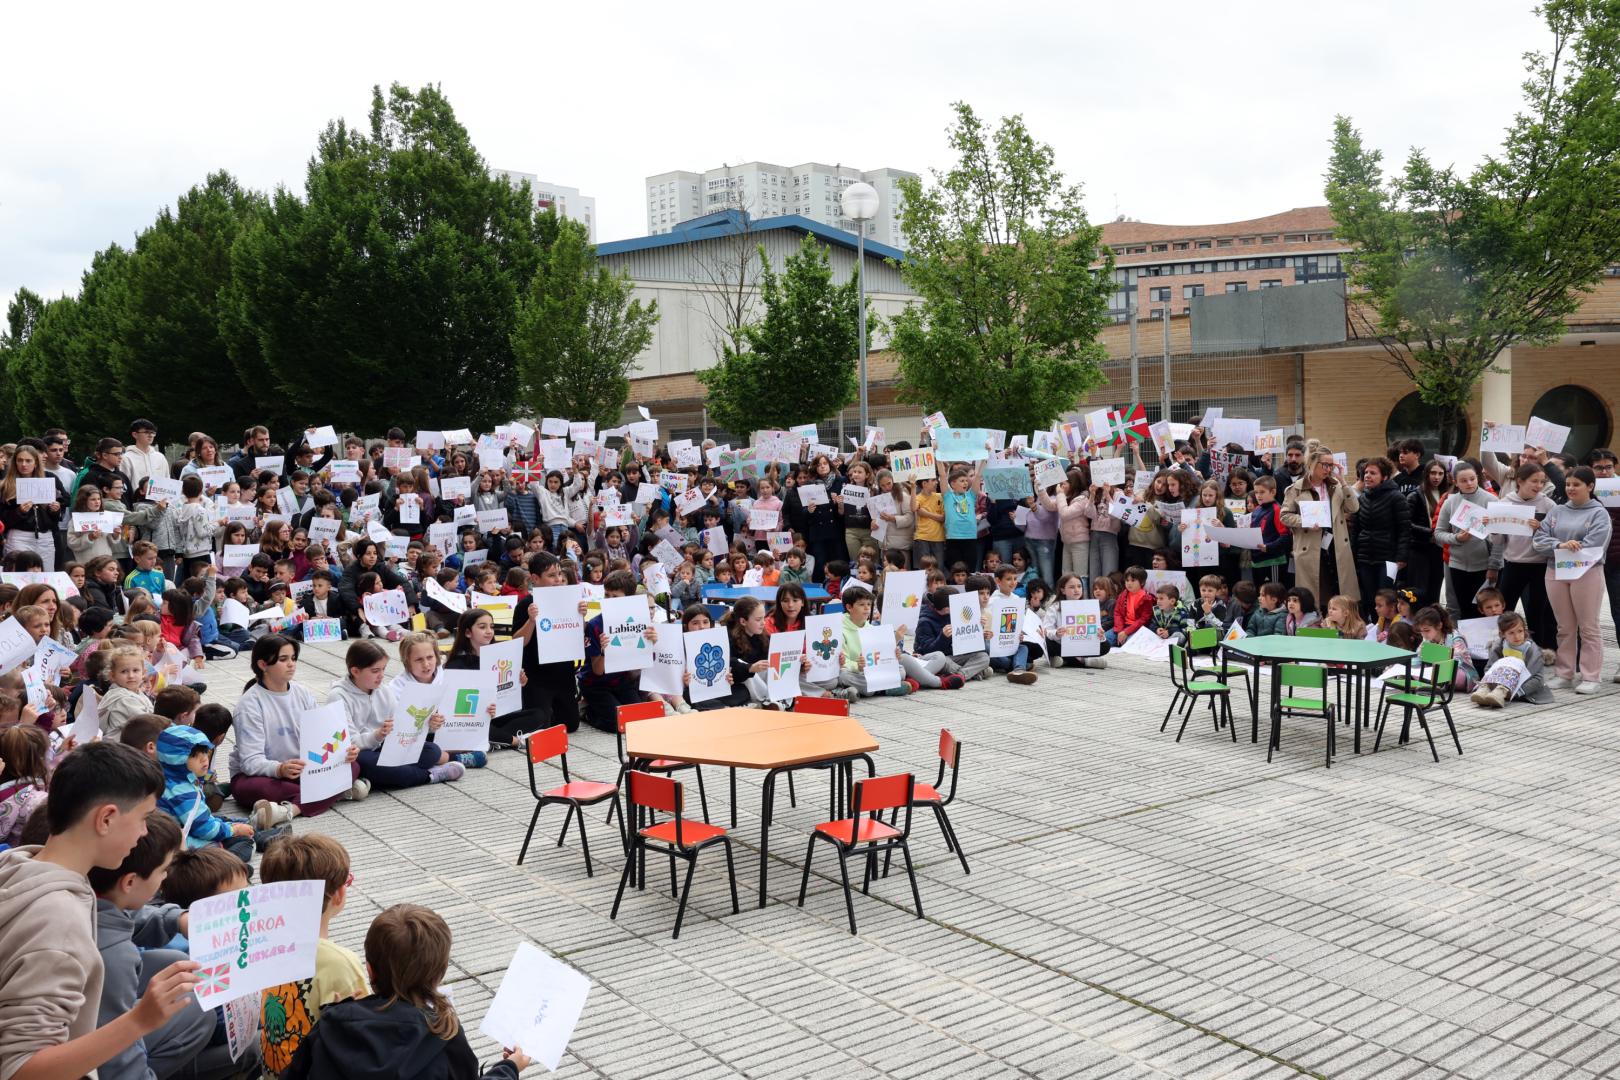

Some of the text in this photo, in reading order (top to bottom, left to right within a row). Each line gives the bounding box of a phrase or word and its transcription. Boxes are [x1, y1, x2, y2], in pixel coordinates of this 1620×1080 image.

[608, 623, 647, 635] Labiaga
[955, 624, 980, 636] ARGIA
[211, 914, 286, 949] NAFARROA
